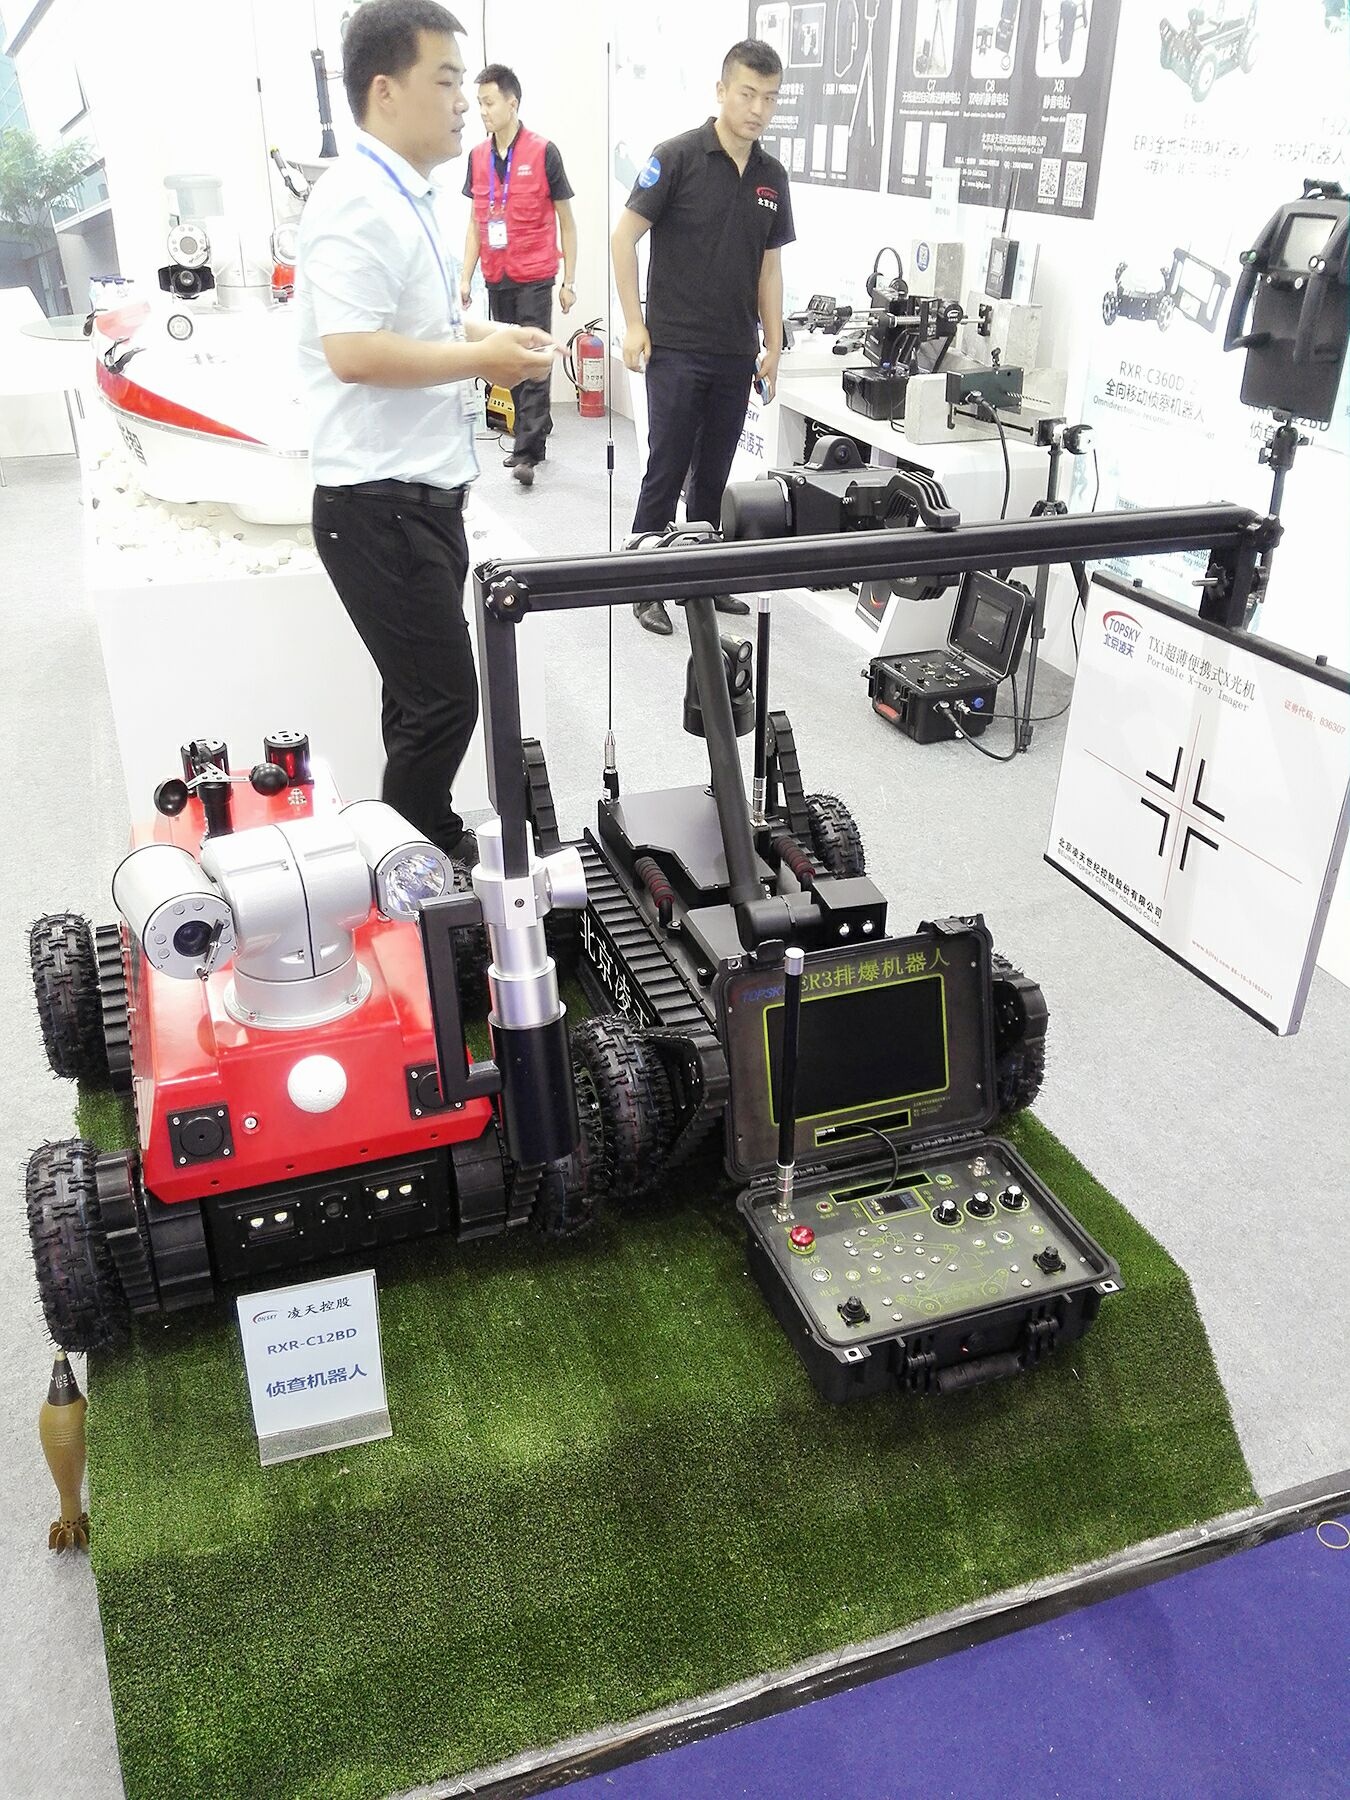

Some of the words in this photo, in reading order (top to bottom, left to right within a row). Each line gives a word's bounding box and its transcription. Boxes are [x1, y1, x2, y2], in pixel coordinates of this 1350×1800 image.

[927, 79, 936, 92] C7
[985, 80, 995, 93] C8
[1053, 79, 1065, 93] X8
[1109, 617, 1141, 643] TOPSKY
[1102, 632, 1135, 658] 北京凌天
[1146, 654, 1185, 680] Portable
[1187, 677, 1213, 696] X-ray
[1216, 690, 1250, 712] Imager
[287, 1296, 352, 1319] 凌天控股
[267, 1327, 358, 1355] RXR-C12BD
[265, 1363, 368, 1399] 侦查机器人
